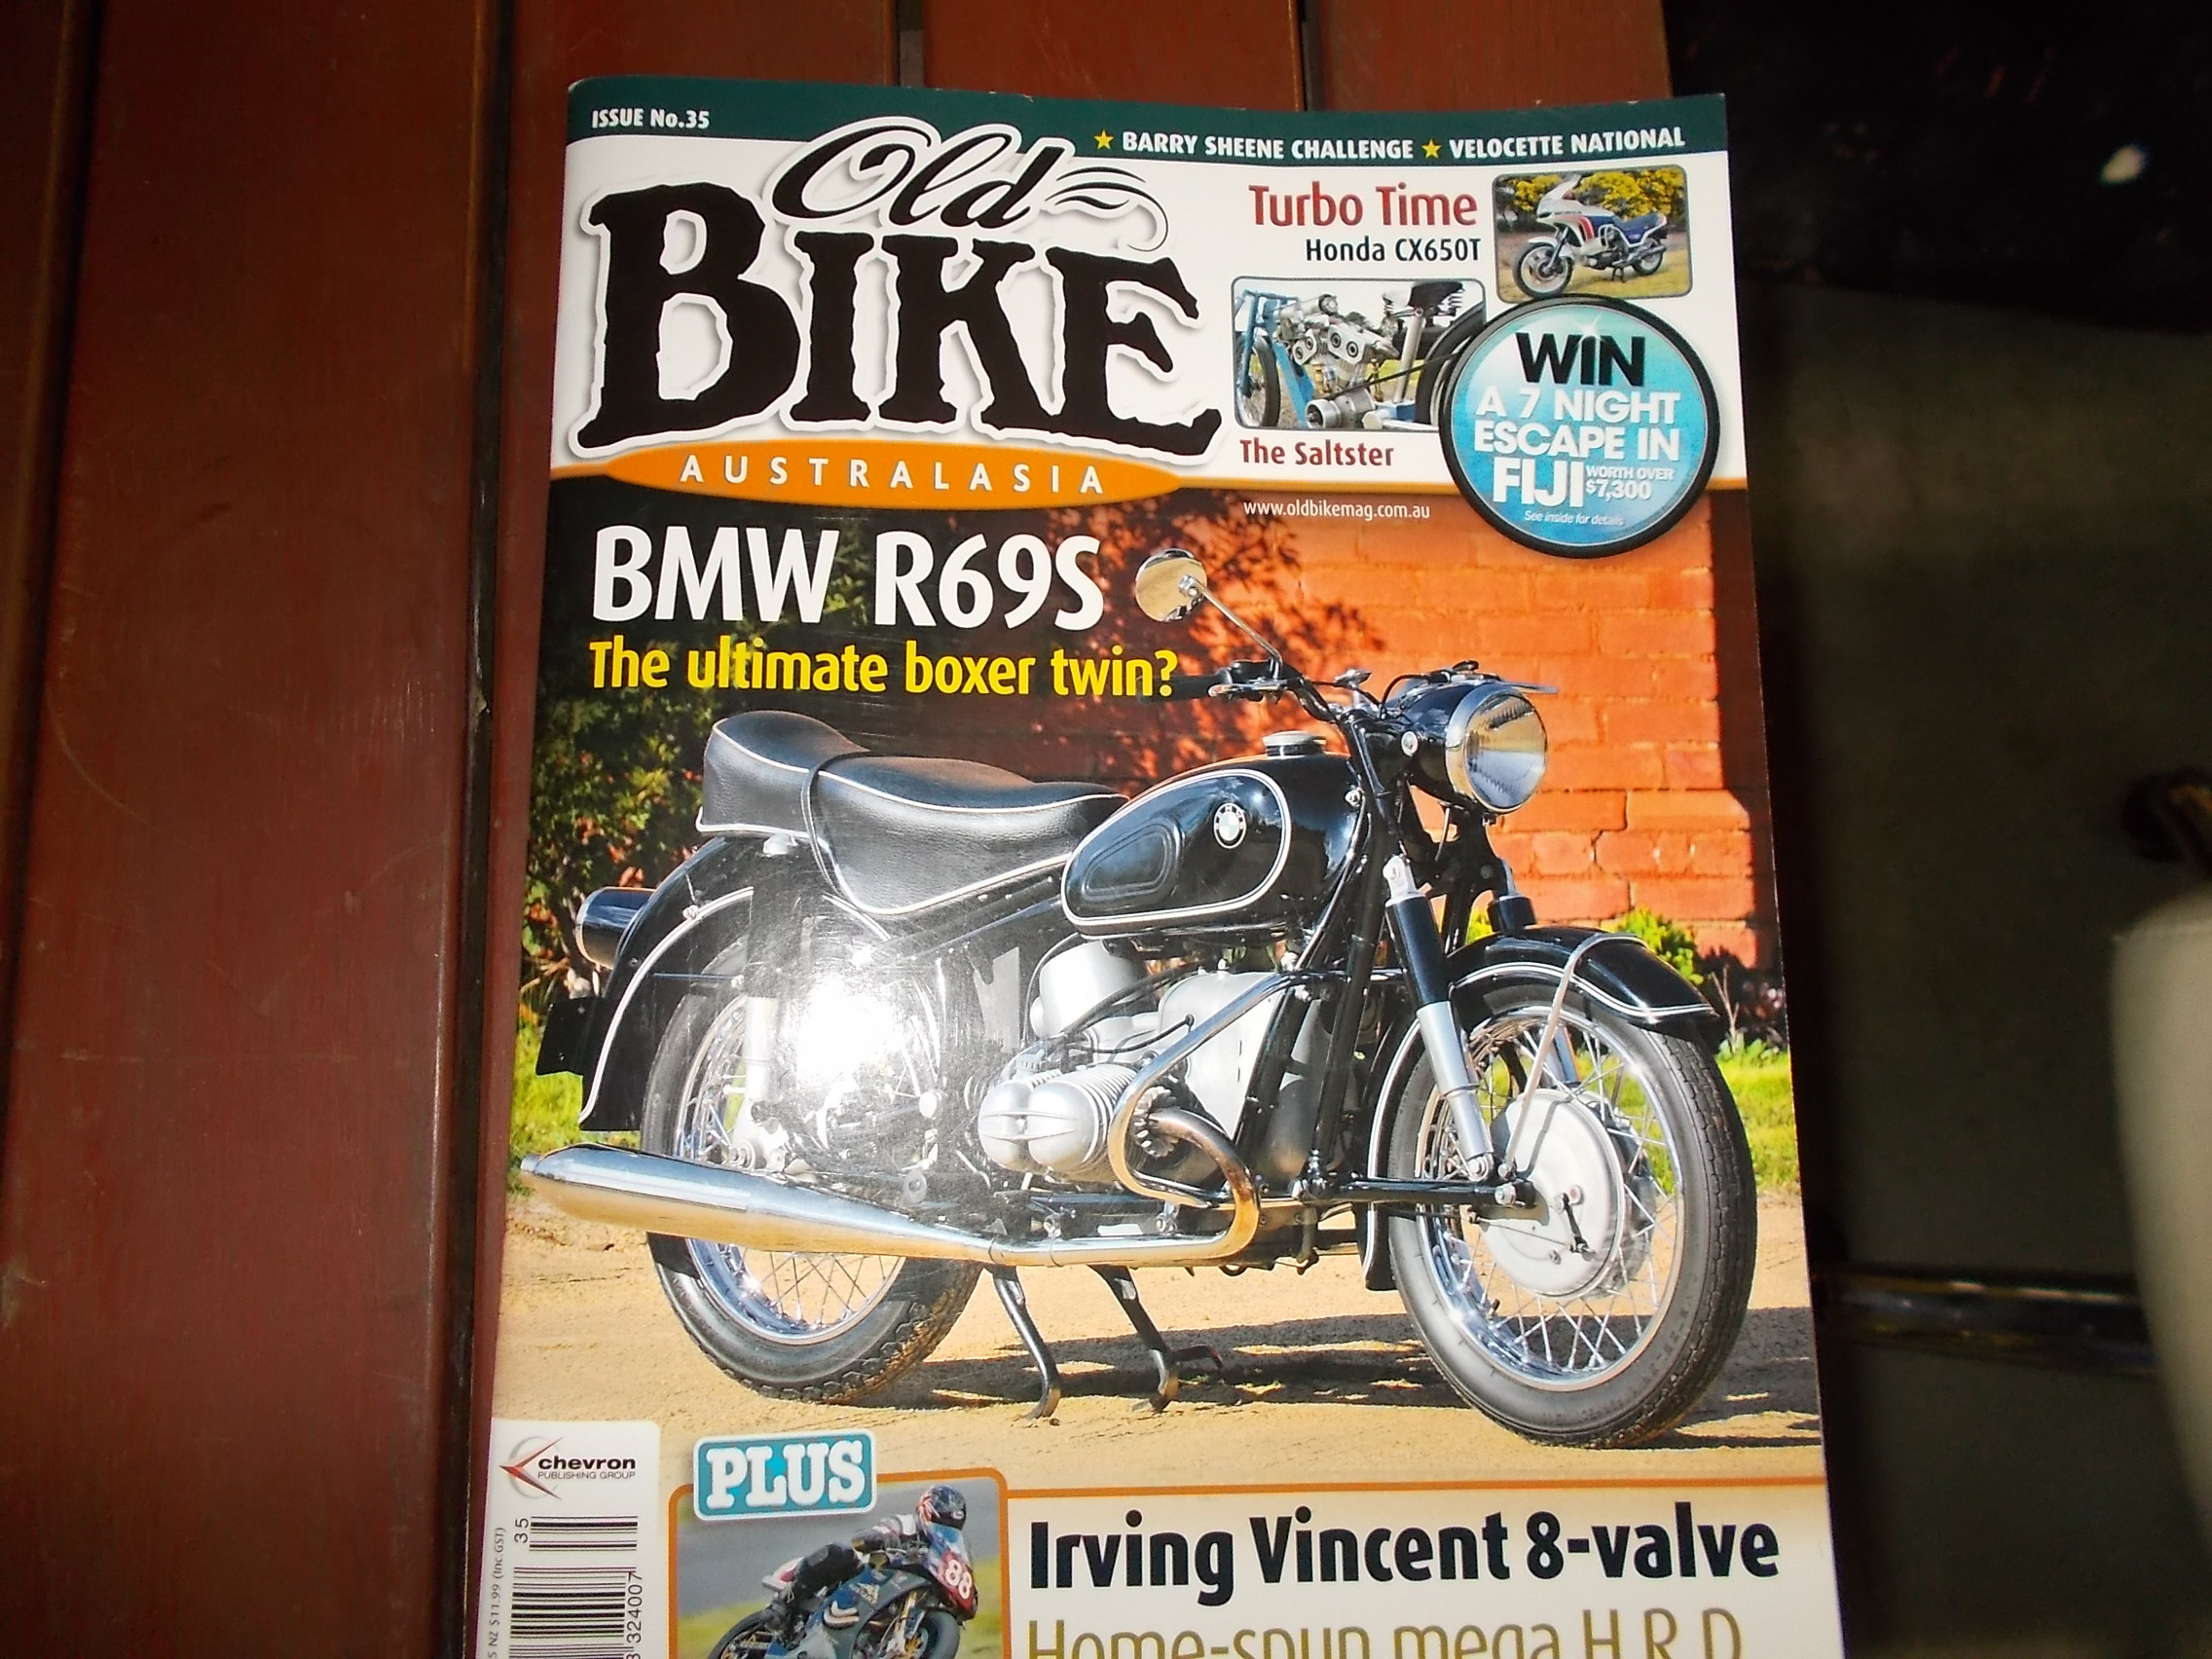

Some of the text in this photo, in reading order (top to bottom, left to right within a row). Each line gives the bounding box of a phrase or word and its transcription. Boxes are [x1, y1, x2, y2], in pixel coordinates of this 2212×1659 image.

[592, 108, 710, 129] ISSUE No.35
[1123, 130, 1413, 159] BARRY SHEENE CHALLENGE
[1449, 127, 1685, 159] VELOCETTE NATIONAL
[772, 126, 1065, 229] Old
[1248, 181, 1478, 226] Turbo Time
[1307, 236, 1481, 261] Honda CX650T
[577, 182, 1223, 455] BIKE
[1516, 332, 1645, 387] WIN
[1475, 385, 1681, 424] A 7 NIGHT
[1239, 437, 1394, 466] The Saltster
[1474, 420, 1679, 461] ESCAPE IN
[681, 455, 1103, 494] AUSTRALASIA
[1493, 457, 1585, 507] FIJI
[1586, 465, 1674, 480] WORTH OVER
[1586, 480, 1651, 501] $7,300
[1243, 499, 1430, 521] www.oldbikemag.com.au
[1525, 510, 1624, 526] See inside for details
[592, 524, 1104, 631] BMW R69S
[589, 634, 1178, 697] The ultimate boxer twin?
[537, 1471, 636, 1480] PUBLISHING GROUP
[538, 1455, 636, 1470] chevron
[706, 1440, 865, 1509] PLUS
[1030, 1501, 1779, 1606] Irving Vincent 8-valve
[490, 1583, 501, 1626] $11.99
[489, 1631, 499, 1646] NZ
